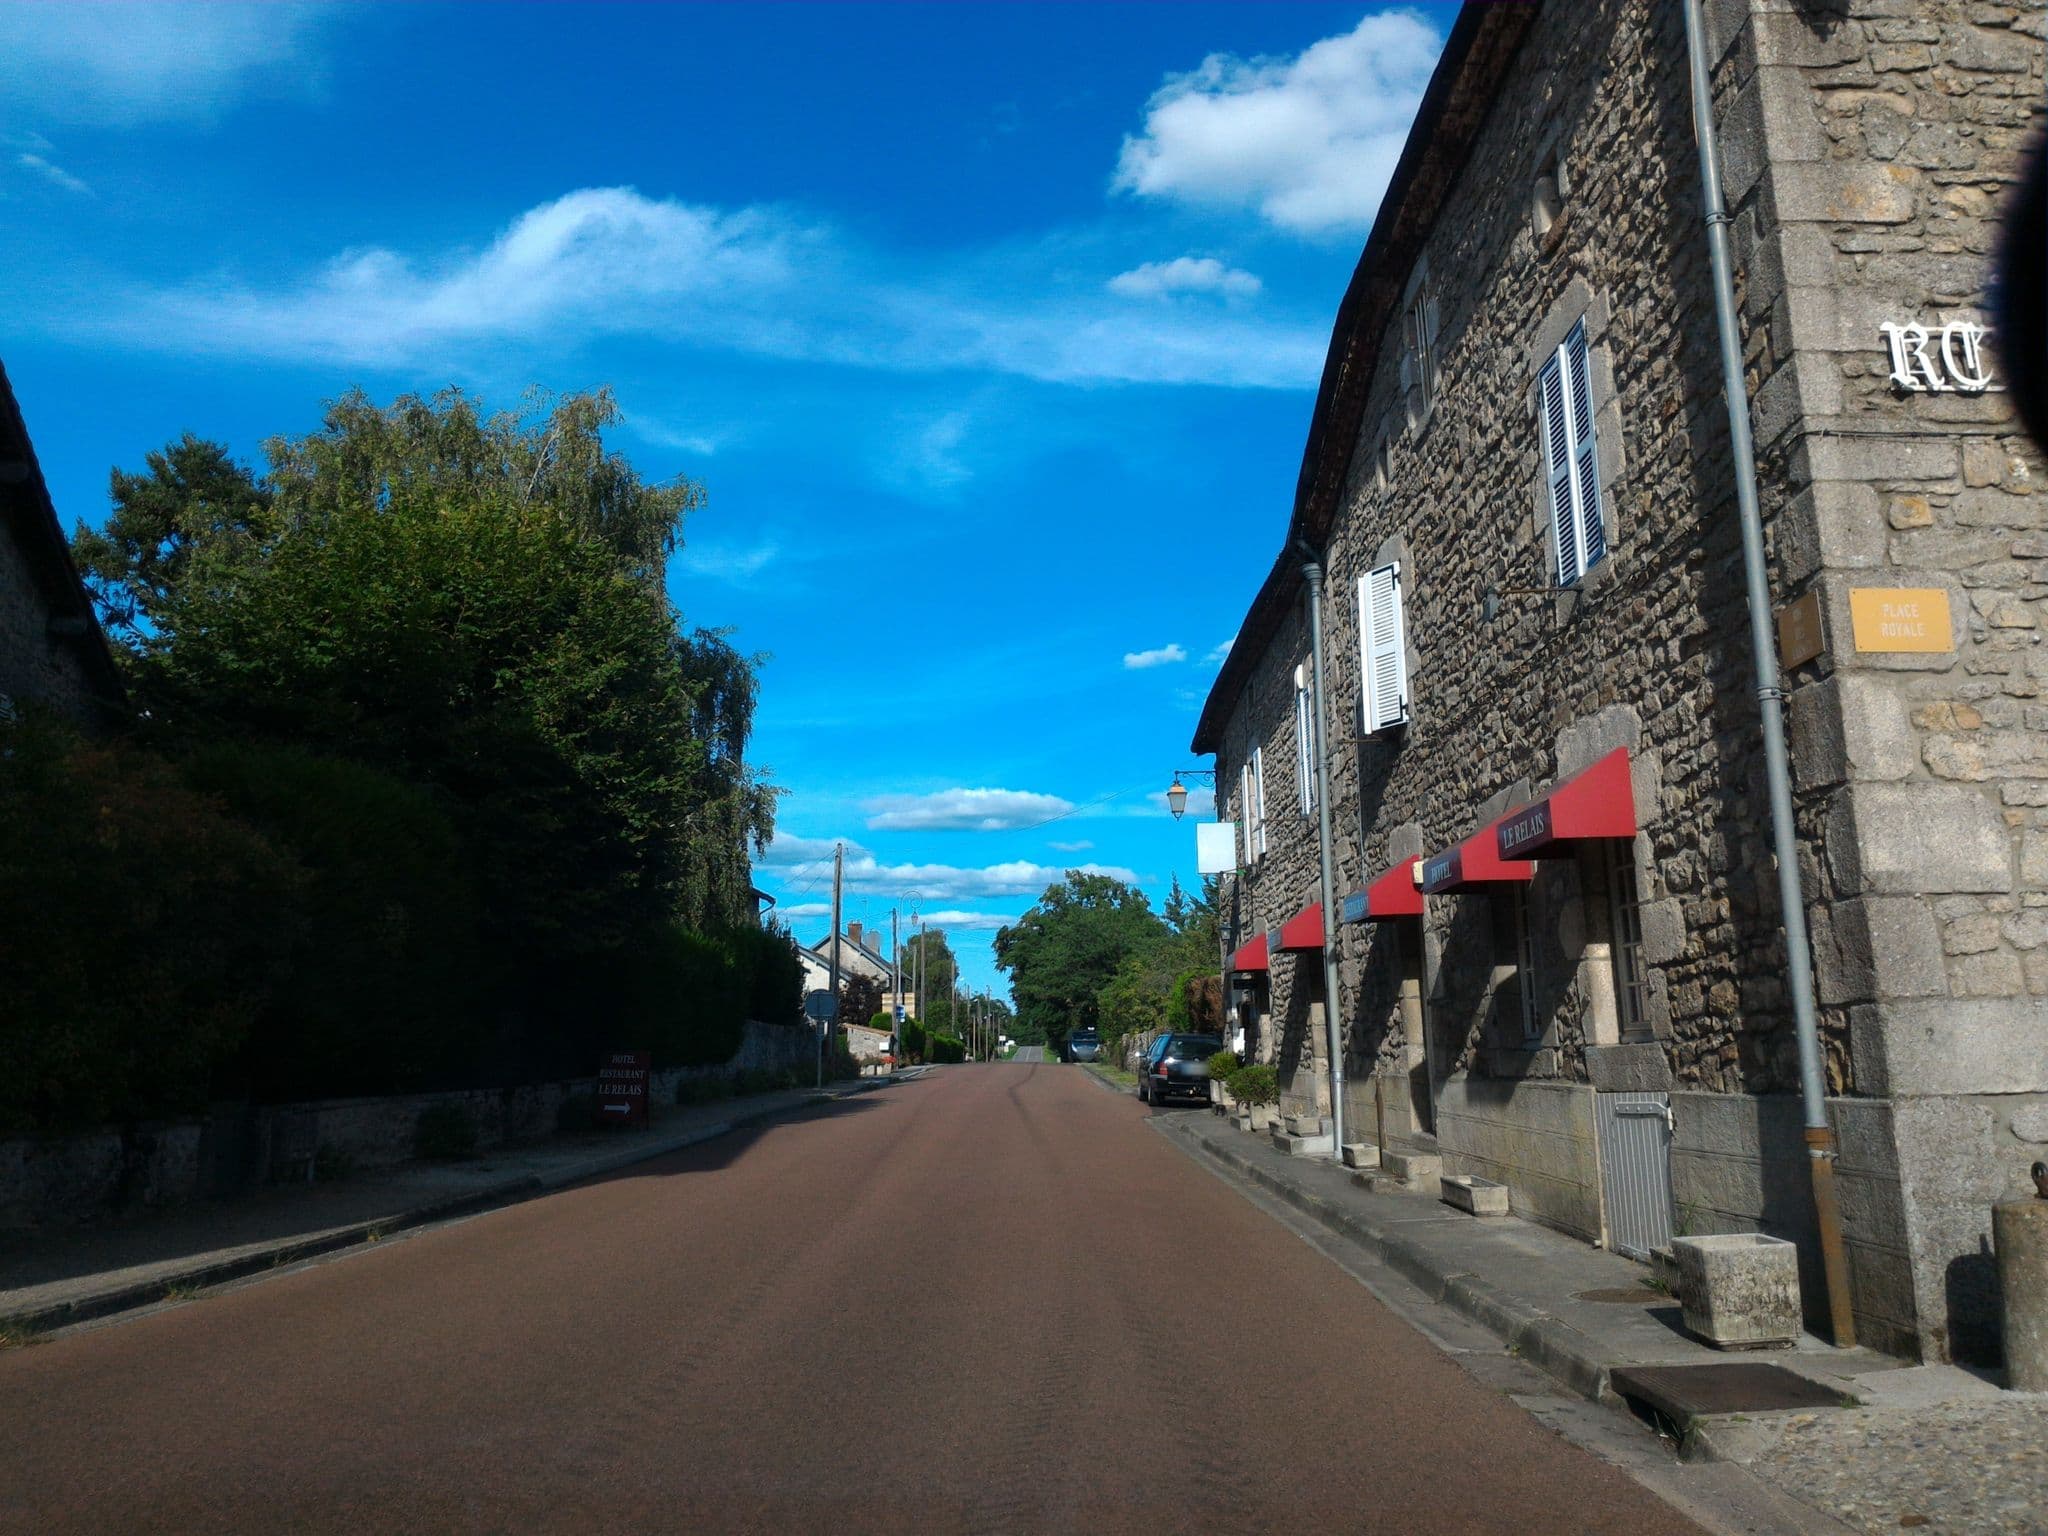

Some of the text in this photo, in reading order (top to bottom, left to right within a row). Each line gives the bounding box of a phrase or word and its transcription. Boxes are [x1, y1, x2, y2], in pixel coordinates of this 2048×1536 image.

[1882, 603, 1920, 618] PLACE
[1881, 622, 1926, 637] ROYALE
[1503, 812, 1545, 849] LE RELAIS
[1431, 860, 1452, 884] HOTEL
[599, 1084, 642, 1096] LE RELAIS
